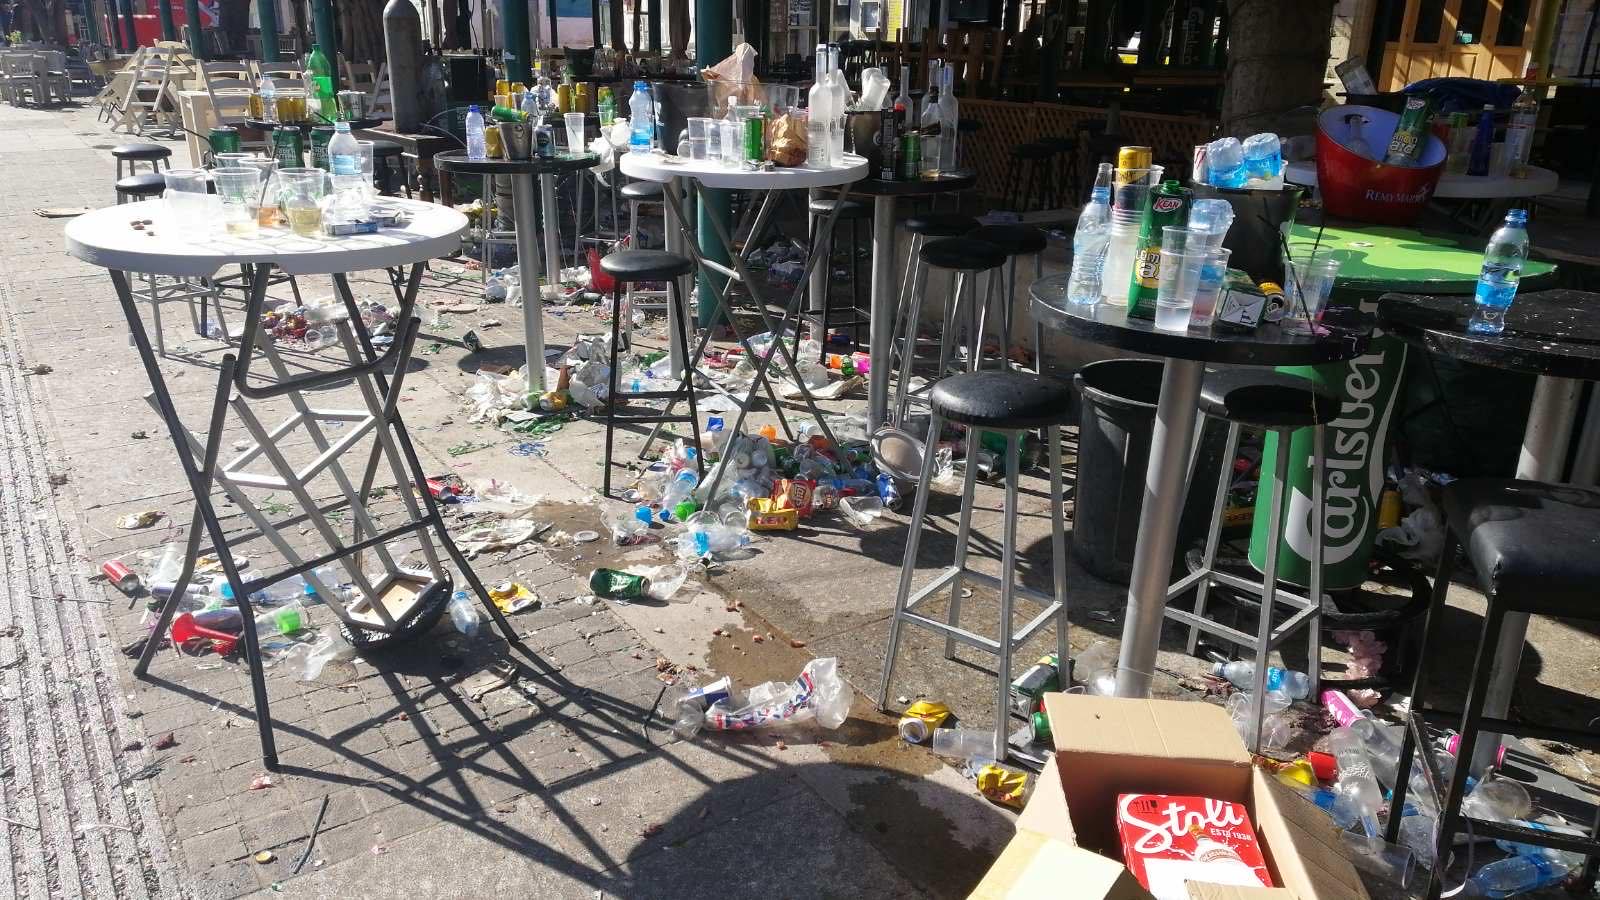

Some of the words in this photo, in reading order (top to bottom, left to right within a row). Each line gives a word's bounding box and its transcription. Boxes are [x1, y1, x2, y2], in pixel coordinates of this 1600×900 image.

[1155, 198, 1180, 209] KEAN
[1285, 298, 1386, 565] Carlsber
[1119, 794, 1245, 854] Stoli
